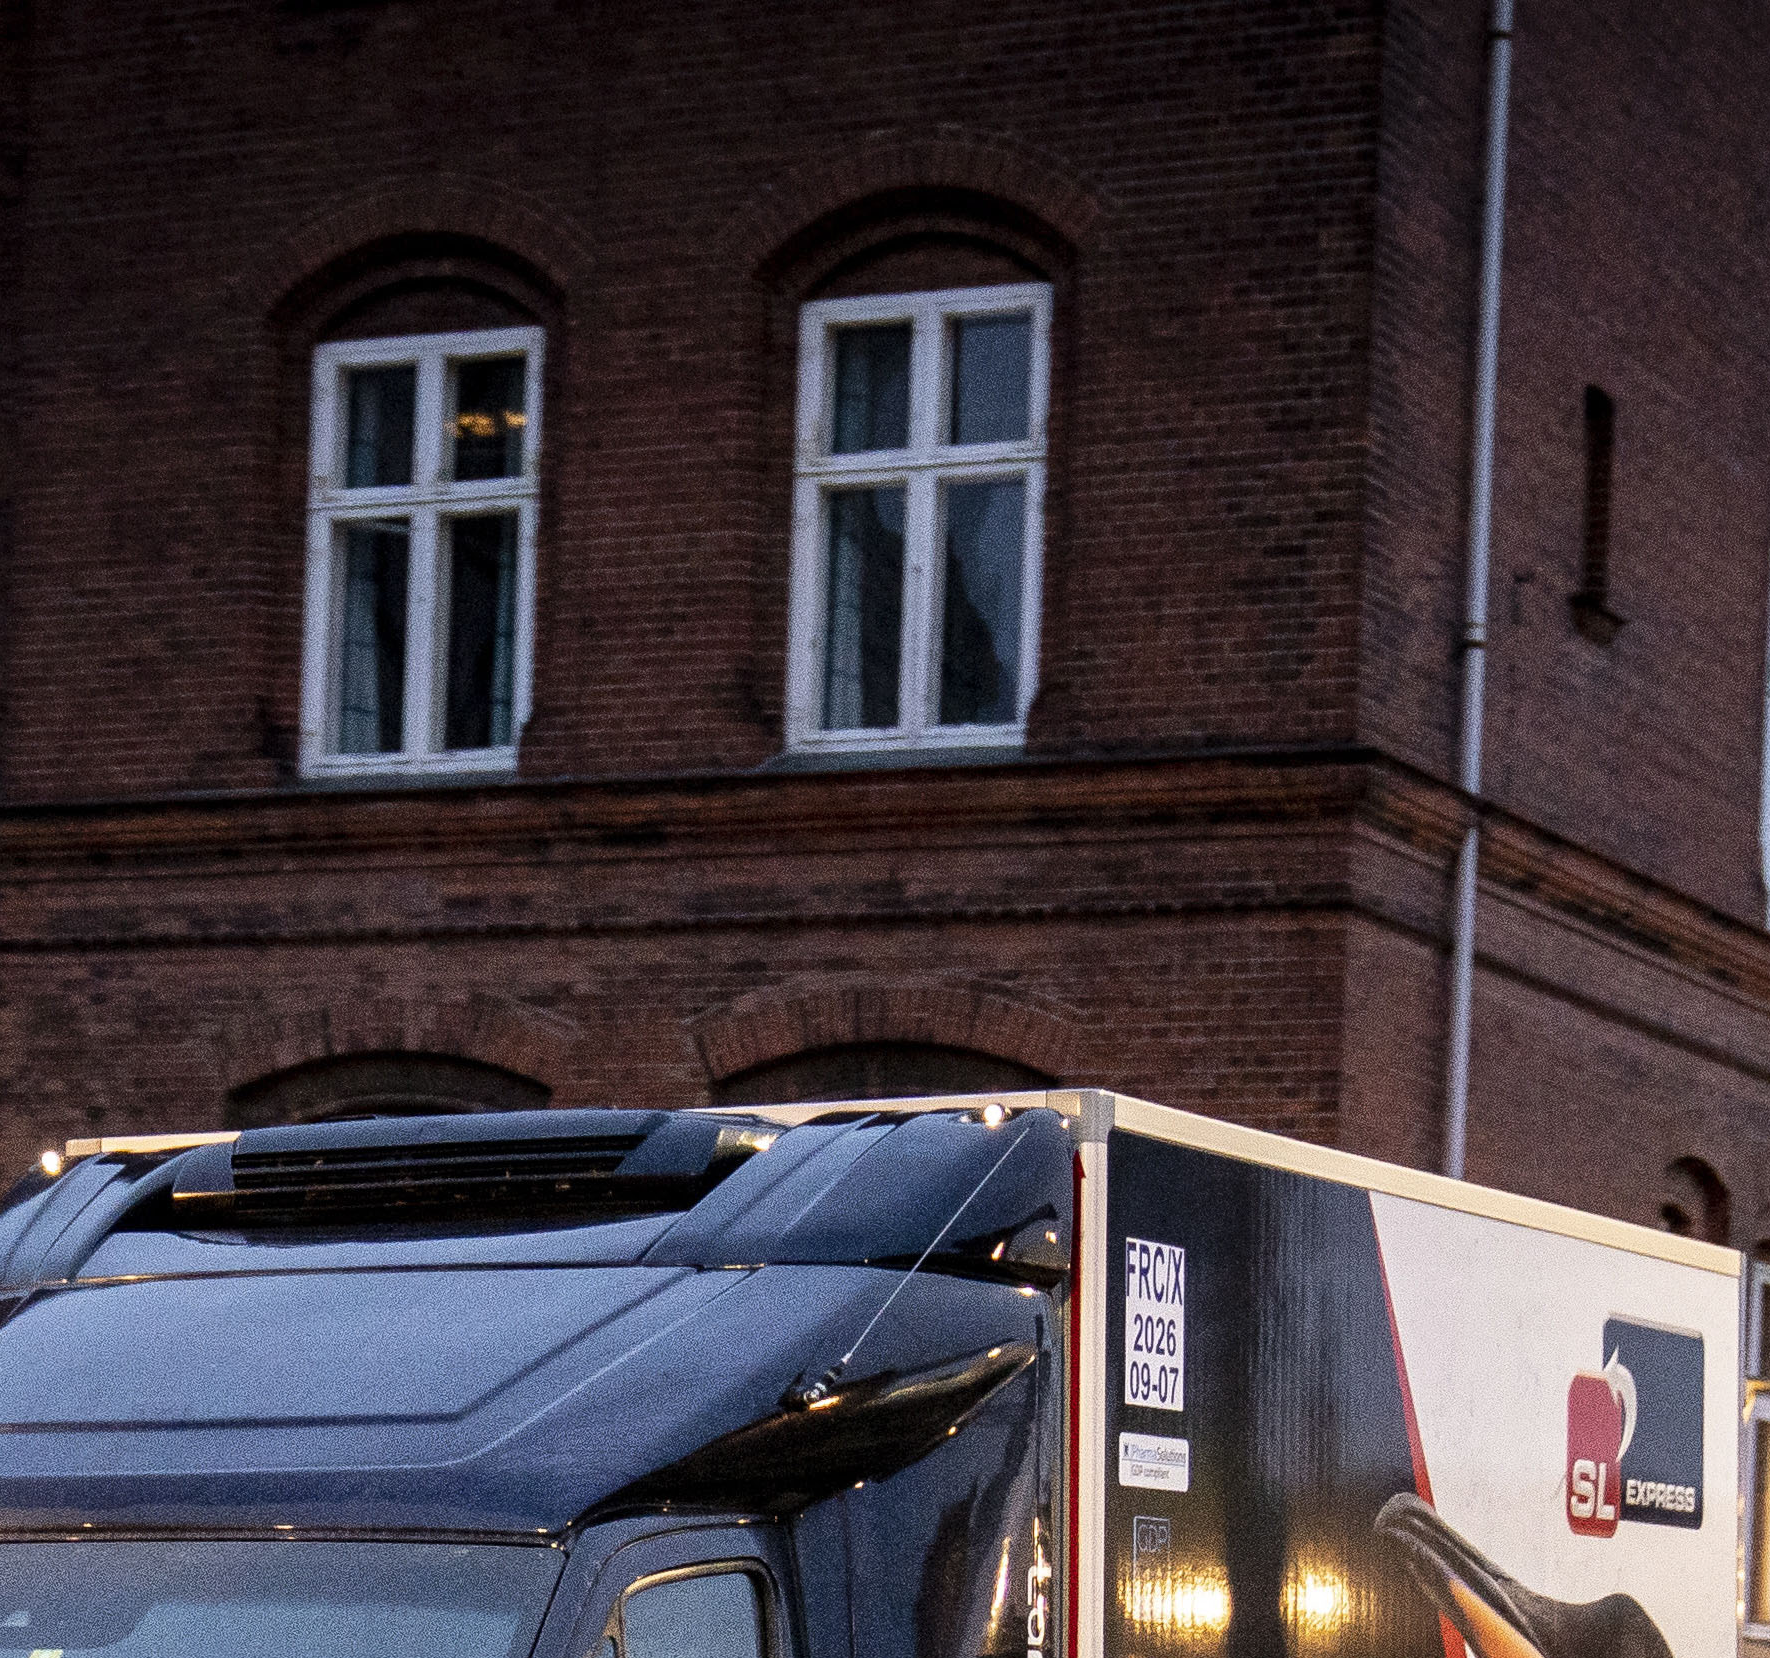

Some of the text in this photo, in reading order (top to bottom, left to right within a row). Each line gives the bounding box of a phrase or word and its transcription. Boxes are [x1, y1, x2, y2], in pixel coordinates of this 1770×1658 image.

[1126, 1241, 1183, 1306] FRC/X
[1133, 1313, 1177, 1357] 2026
[1130, 1361, 1179, 1404] 09-07
[1570, 1458, 1697, 1520] SL EXPRESS
